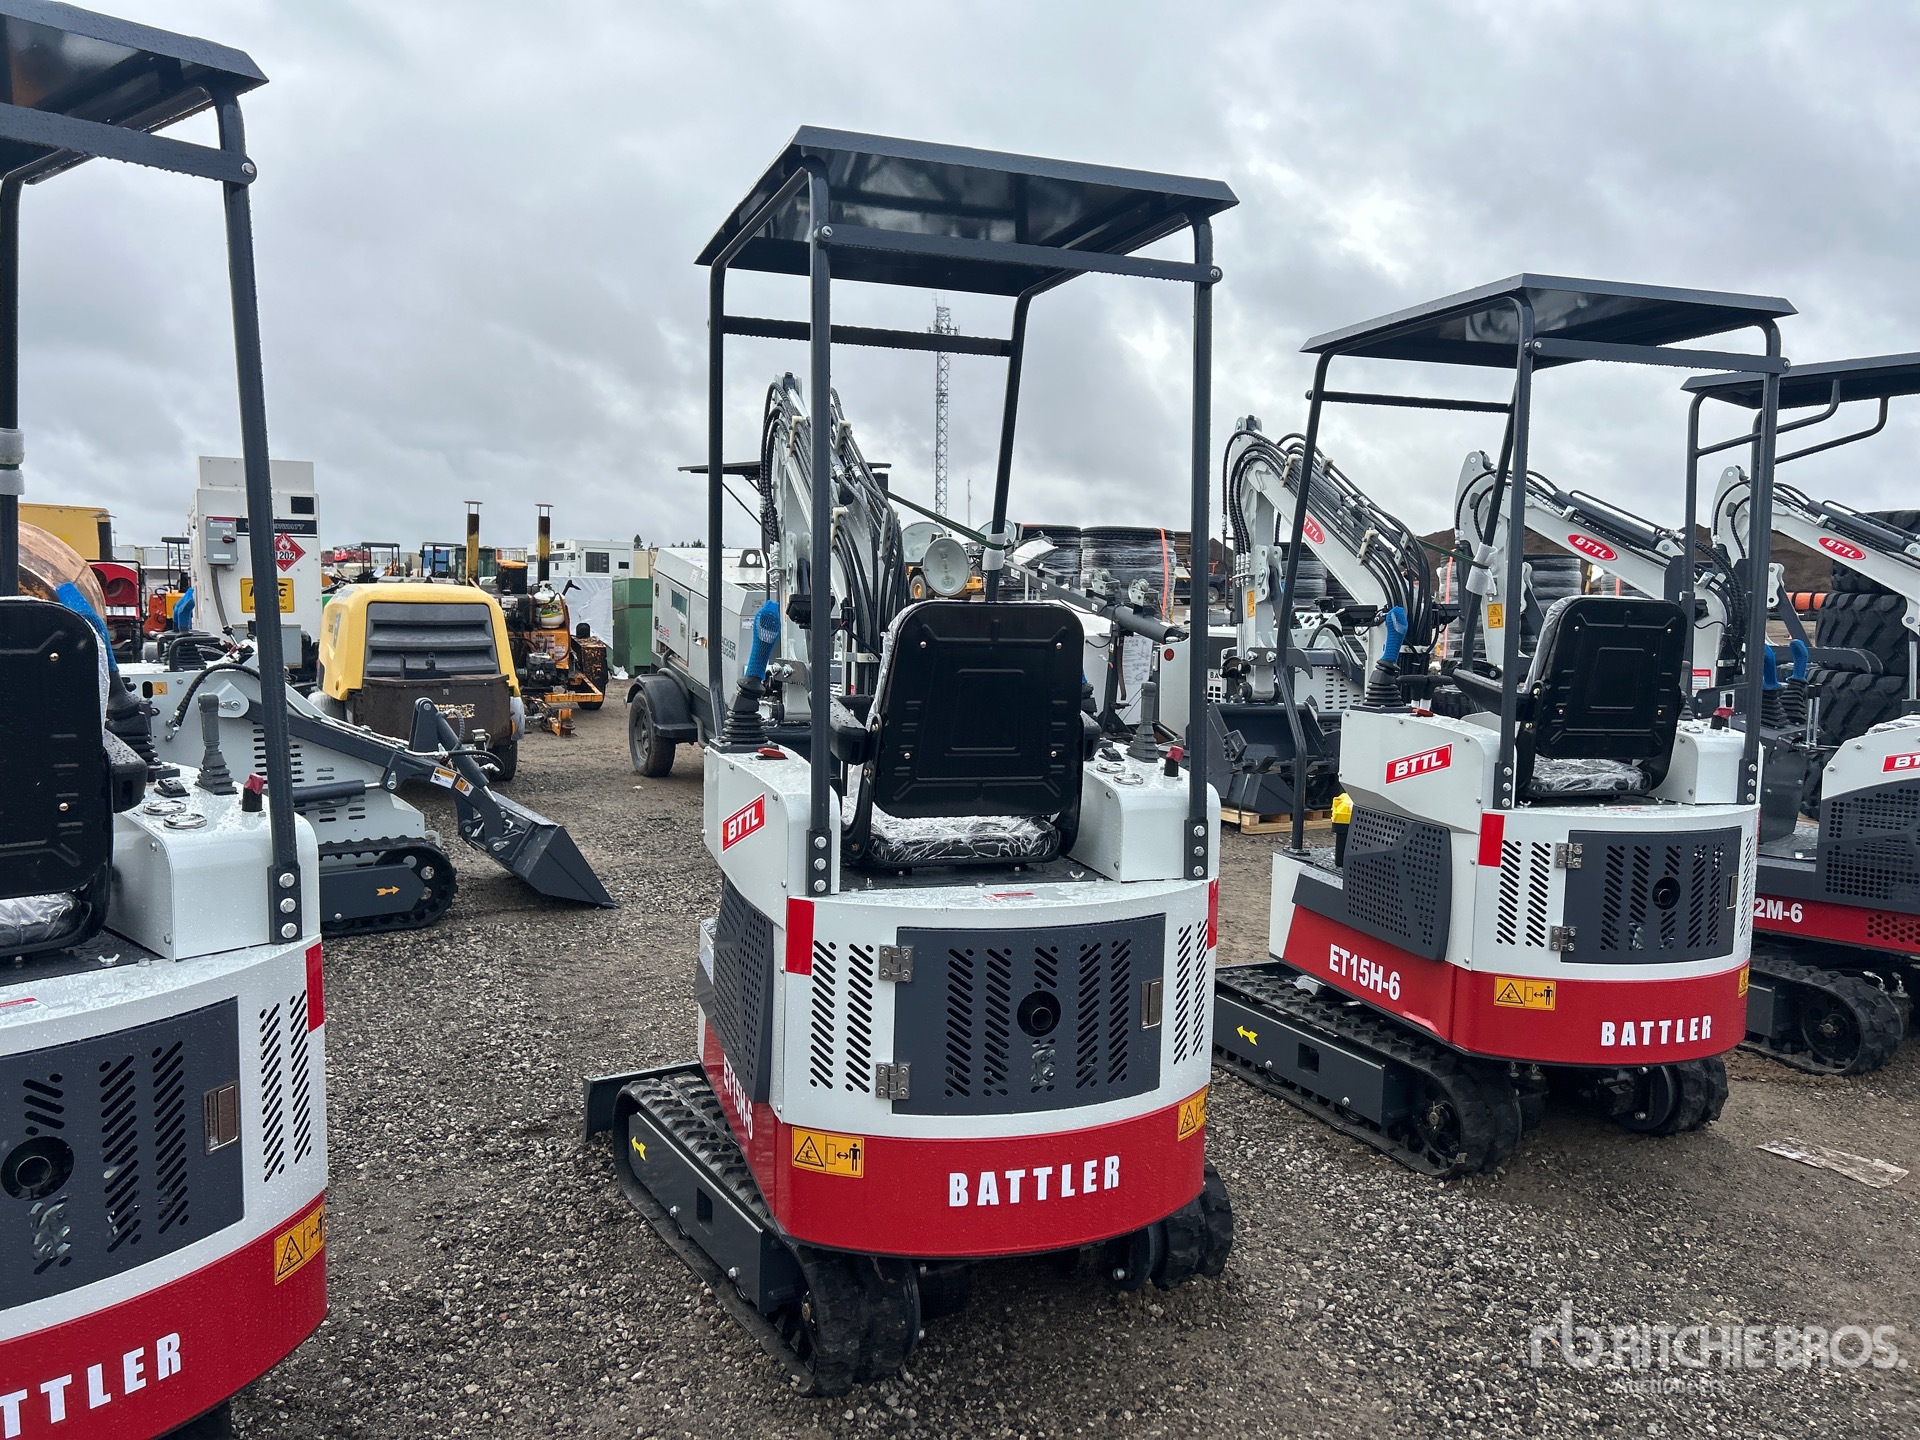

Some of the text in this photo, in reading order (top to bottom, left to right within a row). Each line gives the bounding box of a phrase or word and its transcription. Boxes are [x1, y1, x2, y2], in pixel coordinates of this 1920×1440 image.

[1574, 537, 1607, 558] BTTL
[1825, 539, 1856, 558] BTTL
[722, 637, 736, 652] CKER
[722, 646, 737, 661] USON
[1394, 752, 1443, 778] BTTL
[727, 805, 760, 843] BTTL
[1329, 943, 1401, 1001] ET15H-6
[1600, 1015, 1712, 1047] BATTLER
[948, 1155, 1120, 1207] BATTLER
[0, 1332, 182, 1440] TTLER
